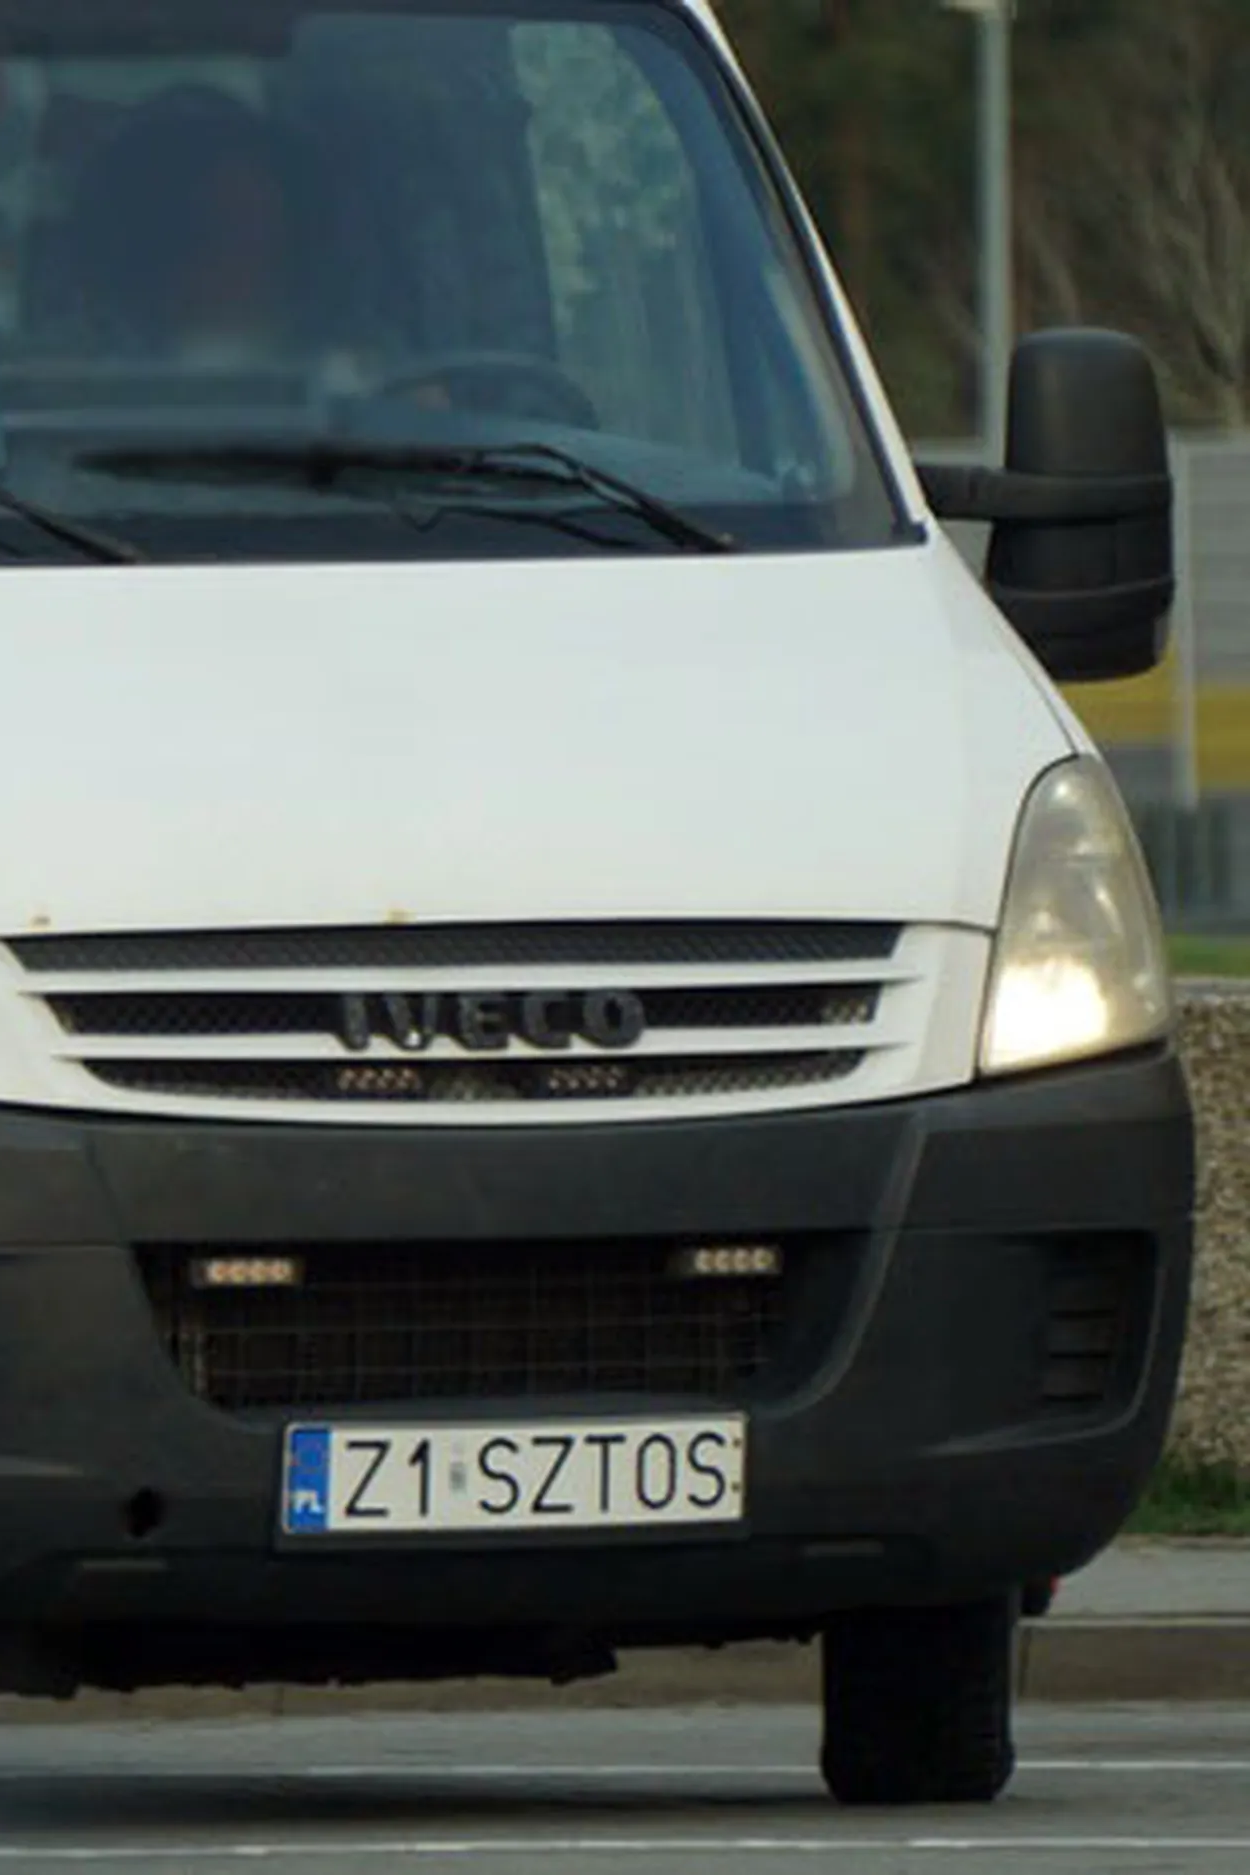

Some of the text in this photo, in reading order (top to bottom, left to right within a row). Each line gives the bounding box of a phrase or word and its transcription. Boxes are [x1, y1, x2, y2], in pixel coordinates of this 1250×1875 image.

[343, 989, 646, 1051] IVECO
[345, 1431, 727, 1517] Z1 SZTOS
